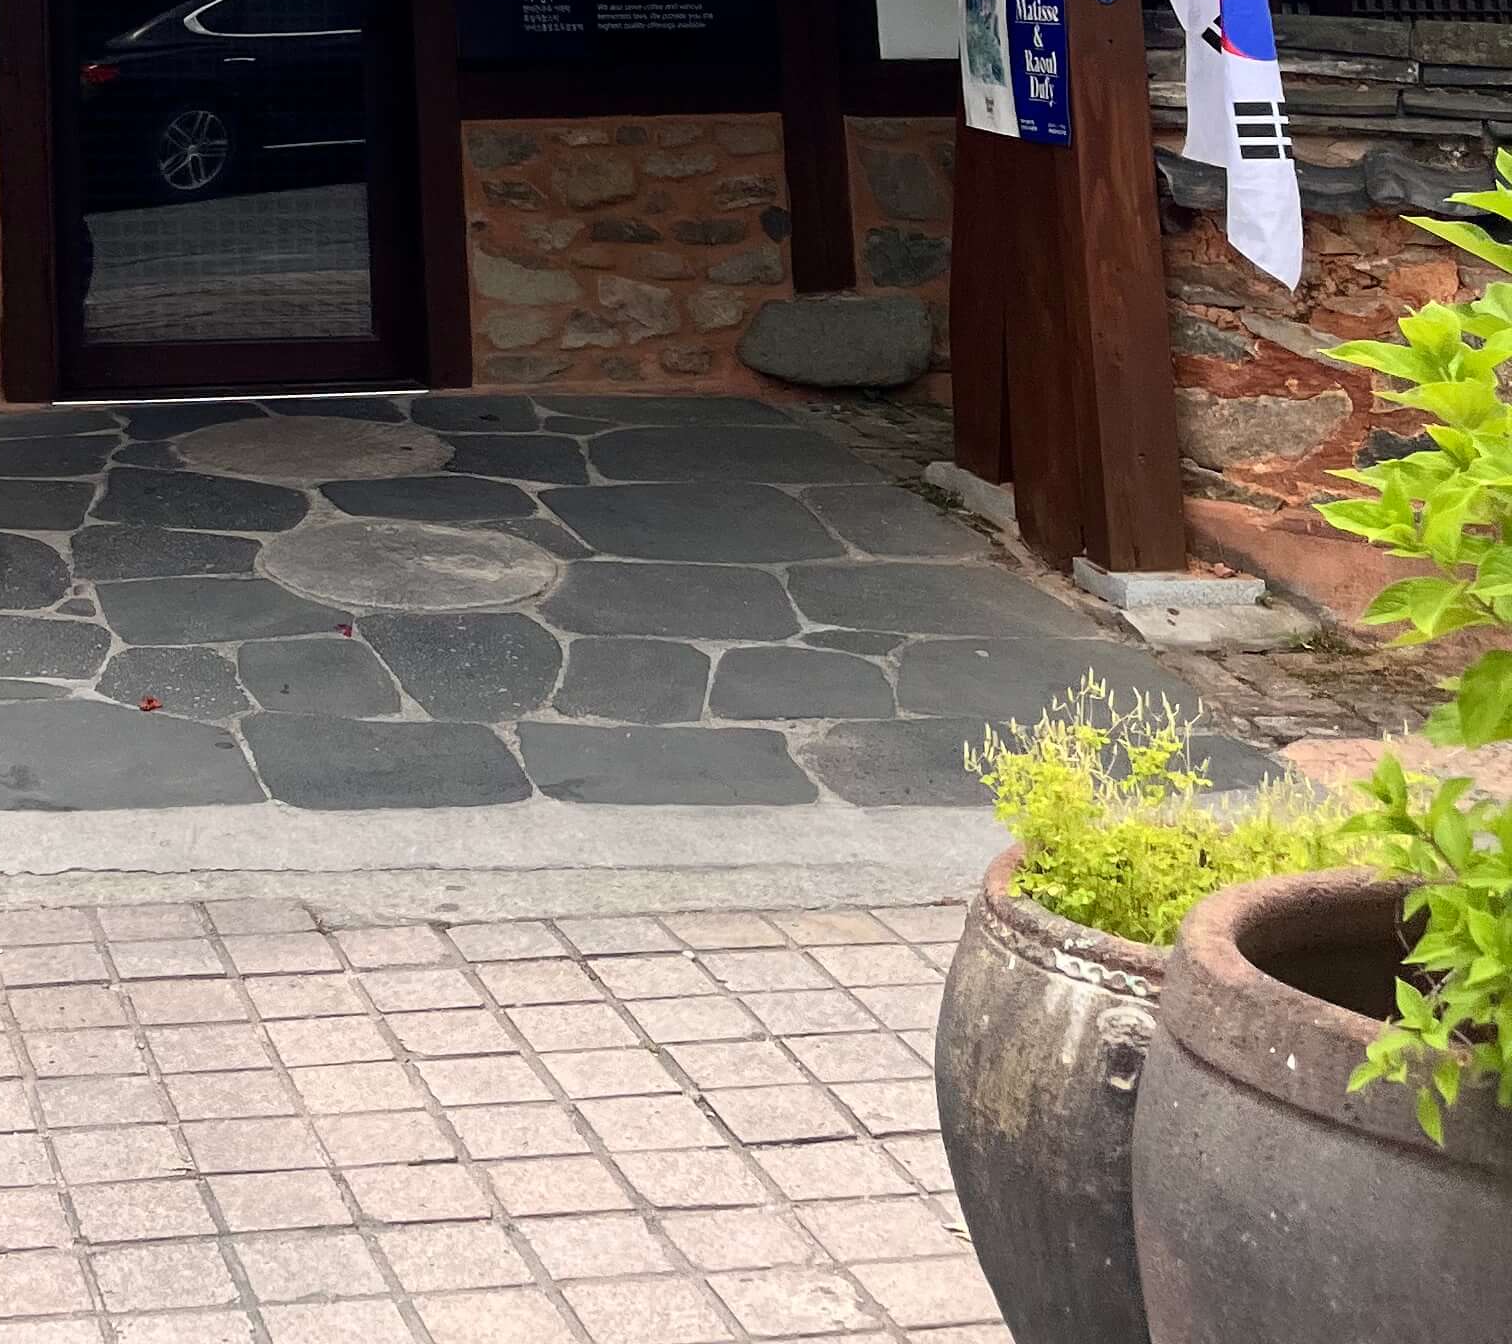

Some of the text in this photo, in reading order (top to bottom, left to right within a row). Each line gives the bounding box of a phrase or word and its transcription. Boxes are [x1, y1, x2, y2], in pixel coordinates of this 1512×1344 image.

[1033, 24, 1044, 48] &
[1024, 49, 1058, 75] Raoul
[1029, 75, 1055, 108] Dufy
